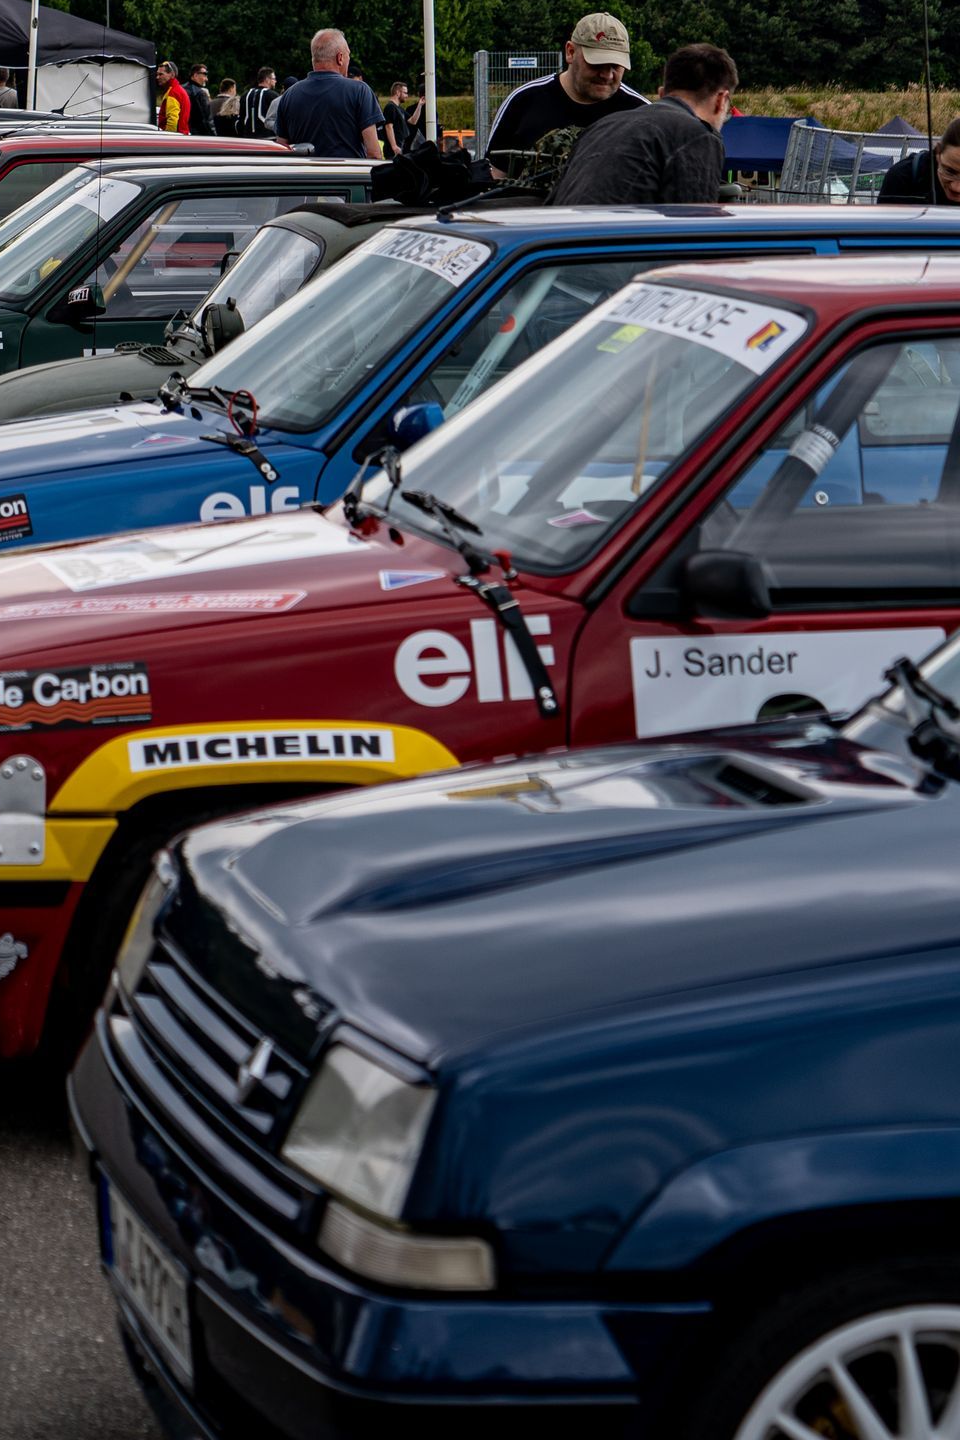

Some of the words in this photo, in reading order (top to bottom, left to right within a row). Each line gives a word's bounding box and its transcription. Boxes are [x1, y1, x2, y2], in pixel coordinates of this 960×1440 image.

[394, 614, 556, 707] elf
[645, 649, 672, 678] J.
[684, 646, 798, 677] Sander
[32, 672, 149, 707] Carbon
[142, 734, 382, 766] MICHELIN
